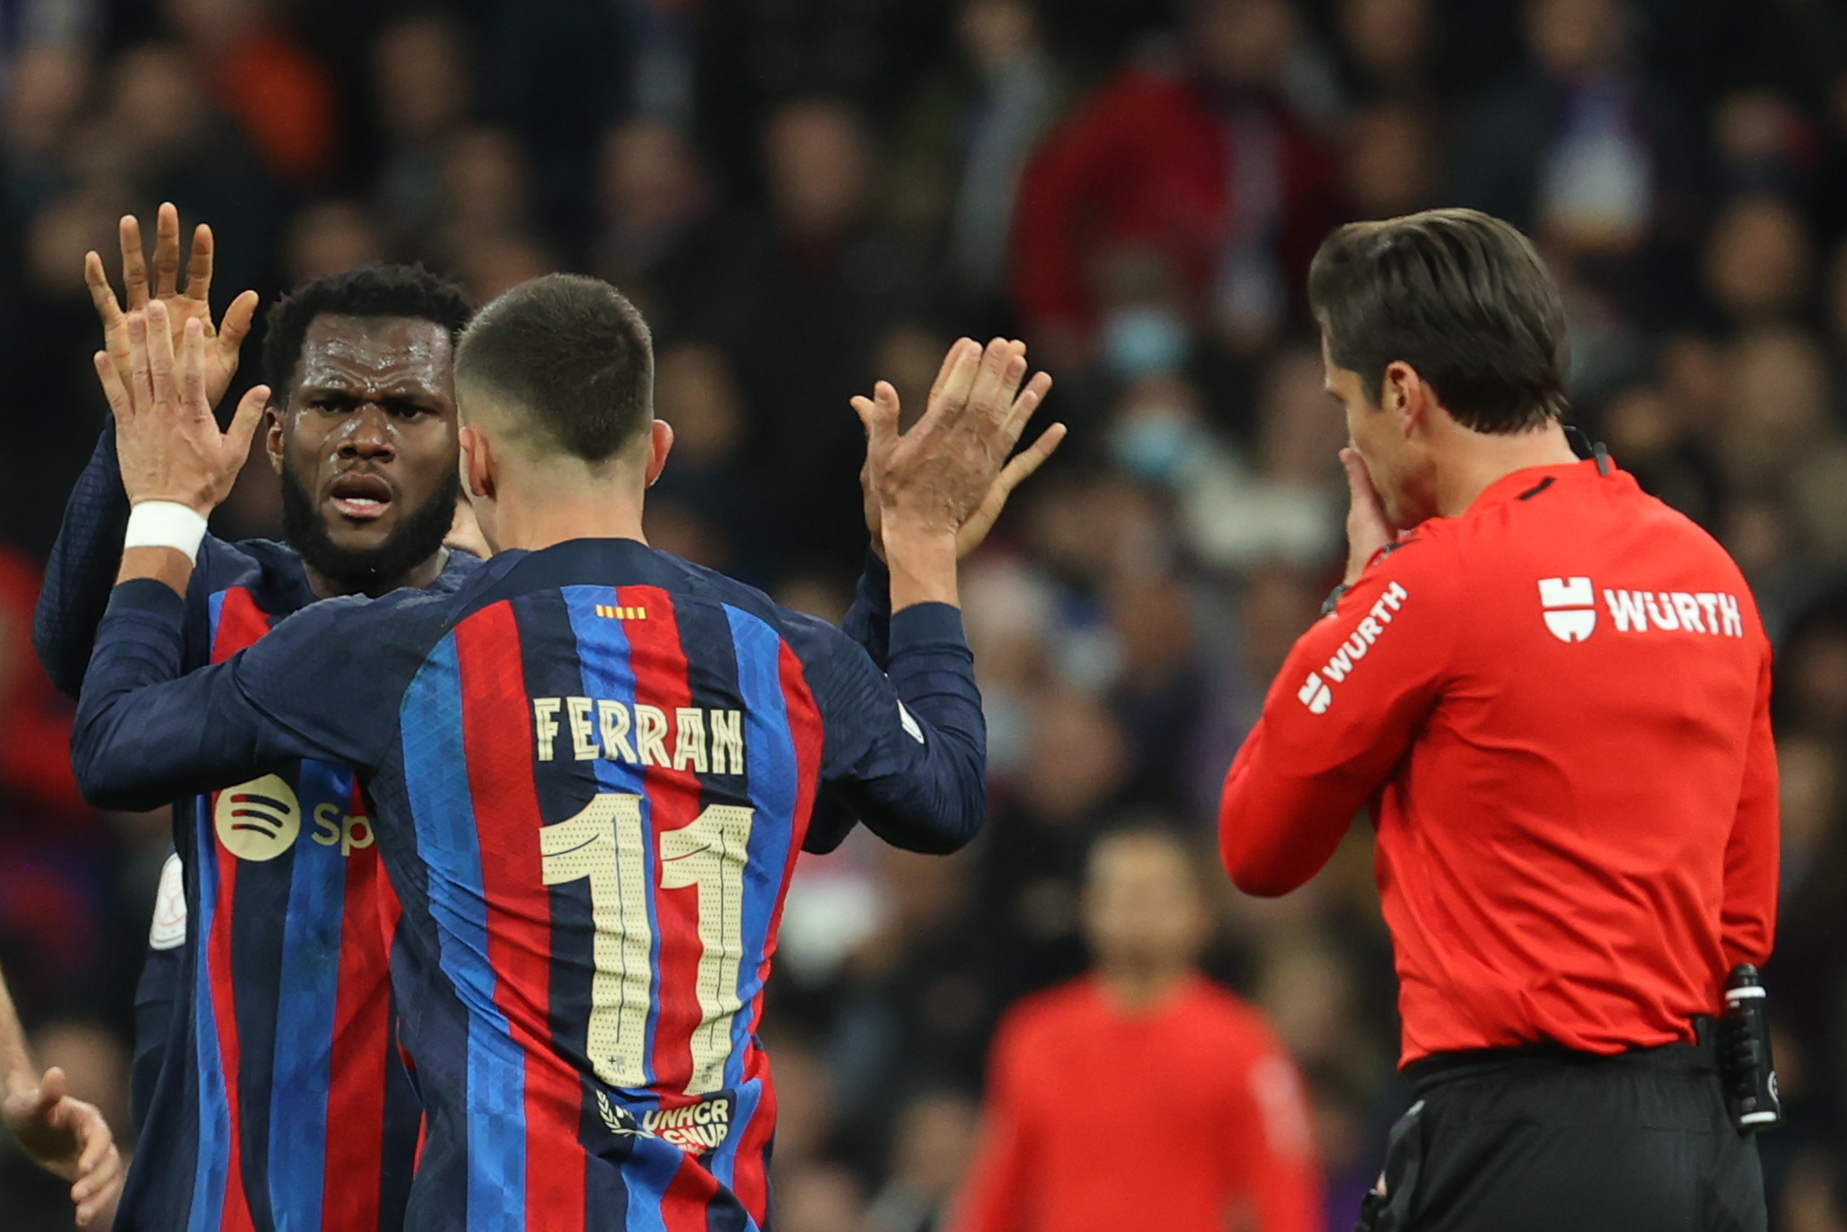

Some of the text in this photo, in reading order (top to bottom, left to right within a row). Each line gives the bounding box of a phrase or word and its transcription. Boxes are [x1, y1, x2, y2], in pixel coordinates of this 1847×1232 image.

[533, 696, 745, 776] FERRAN
[311, 802, 375, 857] Sp
[539, 793, 755, 1096] 11
[642, 1098, 729, 1132] UNHCR
[663, 1123, 728, 1148] CNUR
